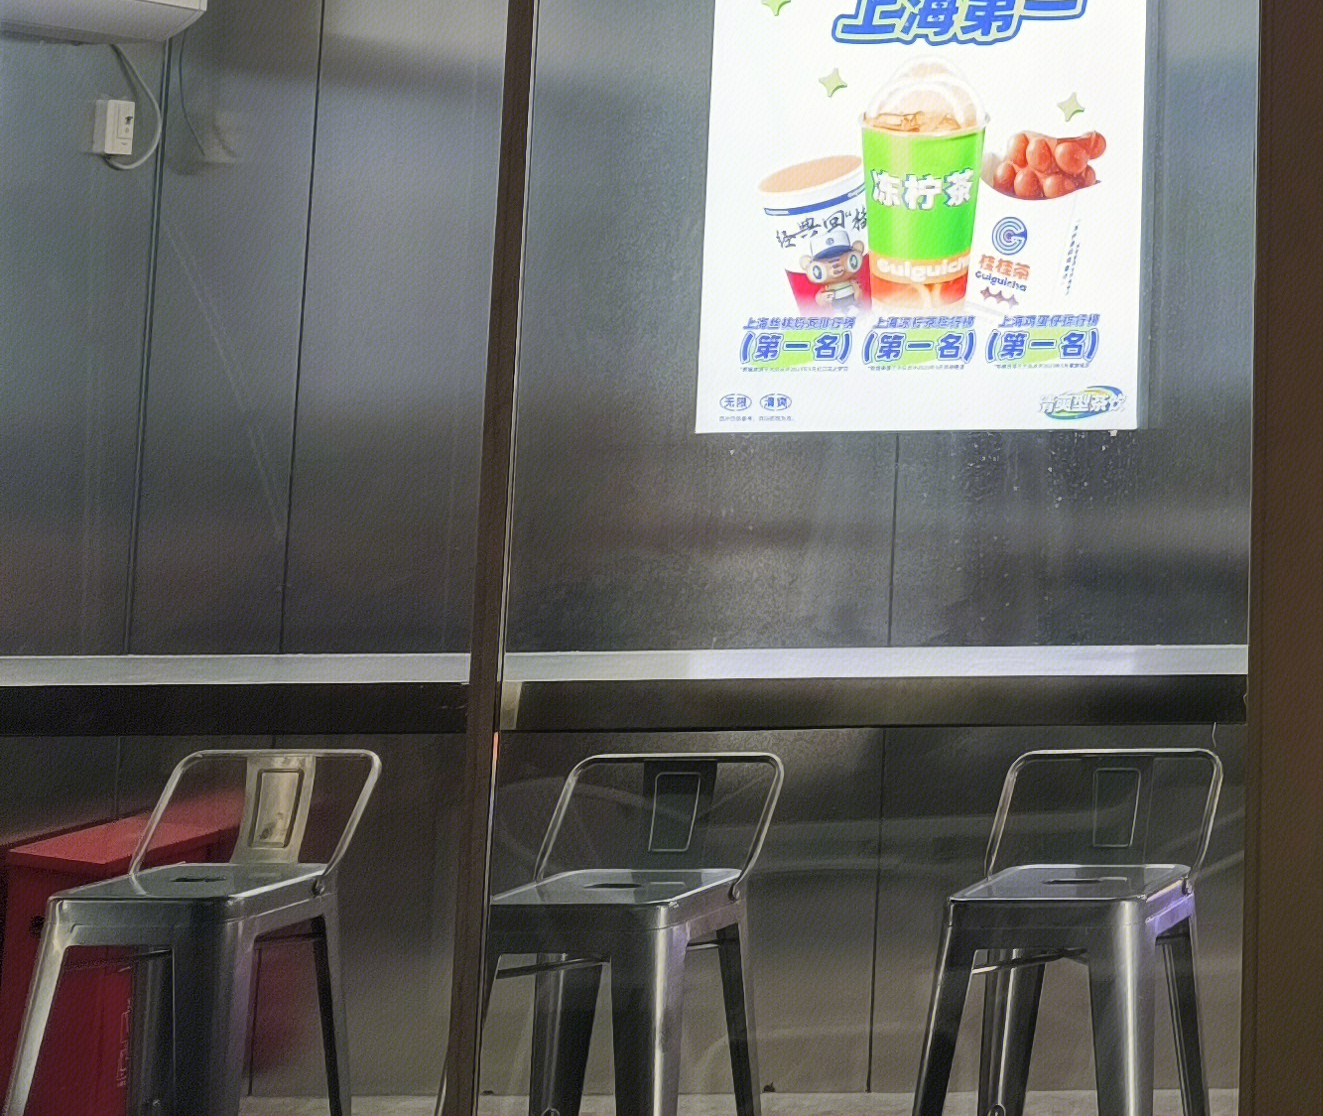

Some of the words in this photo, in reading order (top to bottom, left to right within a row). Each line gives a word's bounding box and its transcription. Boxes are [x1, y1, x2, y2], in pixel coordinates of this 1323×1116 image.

[870, 168, 975, 211] 冻柠茶
[978, 254, 1031, 281] 桂桂茶
[975, 271, 1027, 292] Guiguicha
